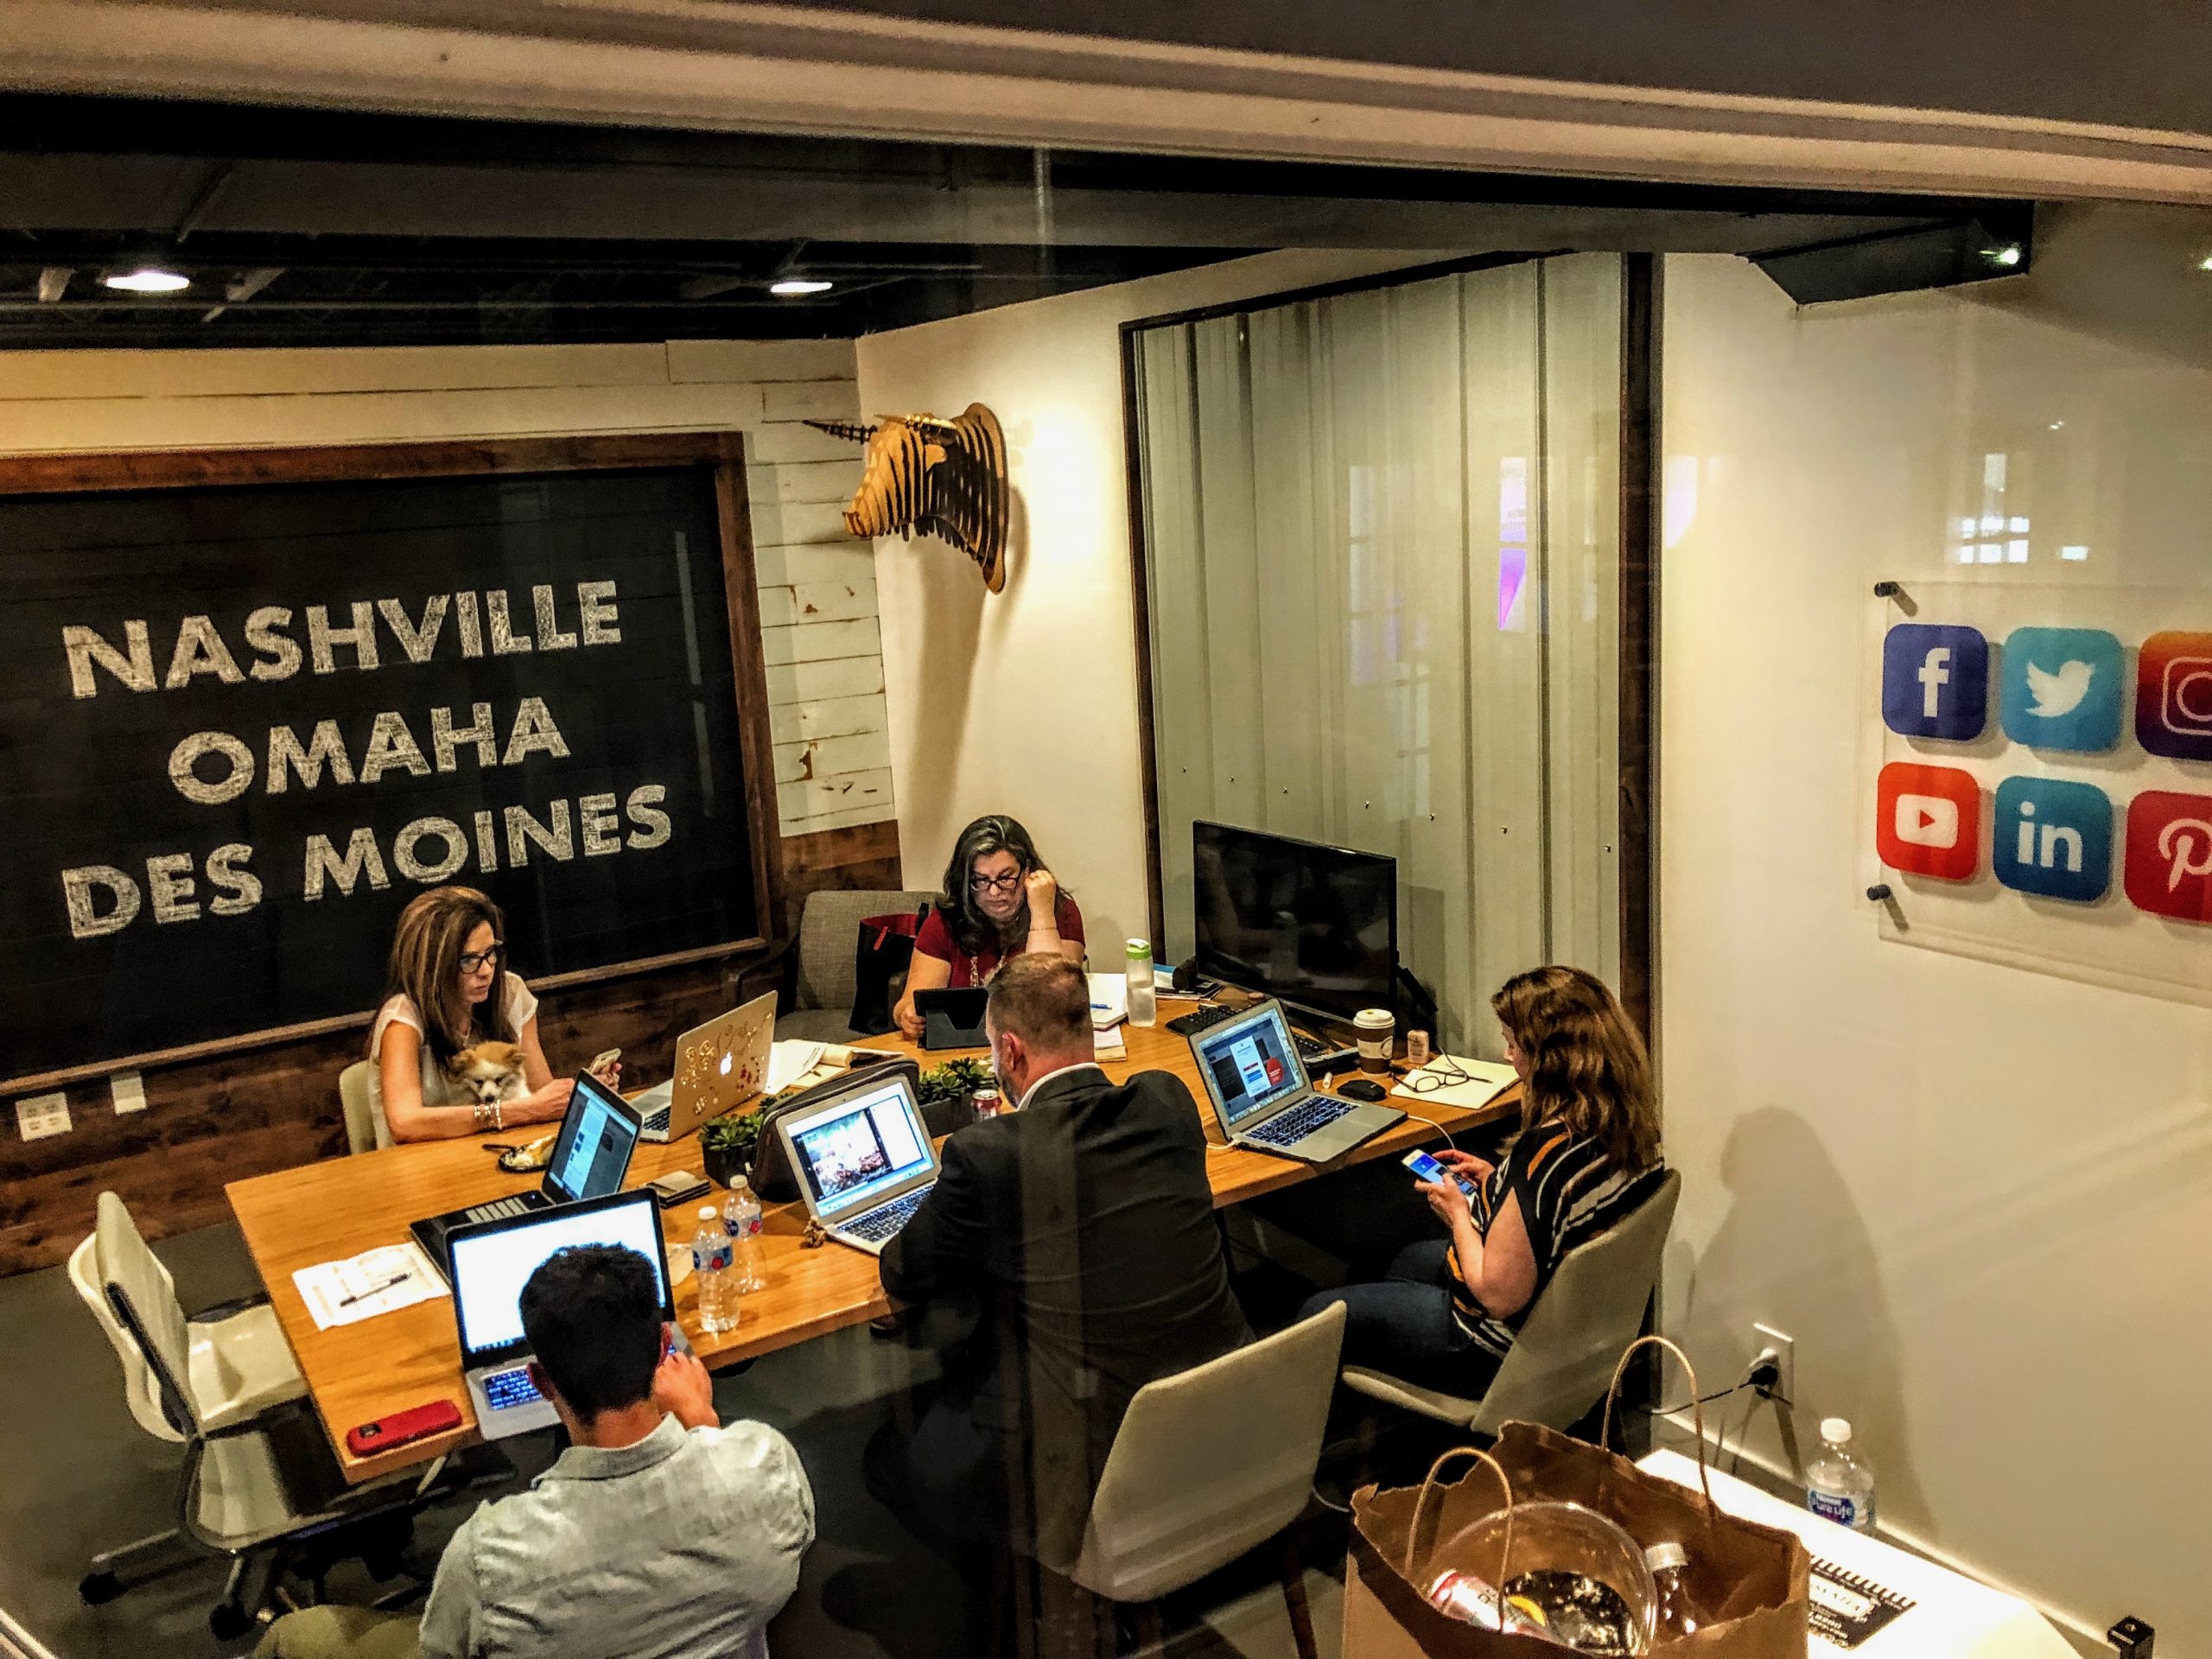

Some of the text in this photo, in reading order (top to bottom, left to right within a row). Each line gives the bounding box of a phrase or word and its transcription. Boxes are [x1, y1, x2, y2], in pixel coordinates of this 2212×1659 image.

[62, 580, 623, 700] NASHVILLE
[168, 696, 572, 805] OMAHA
[61, 784, 672, 940] DES MOINES
[2018, 800, 2083, 873] in
